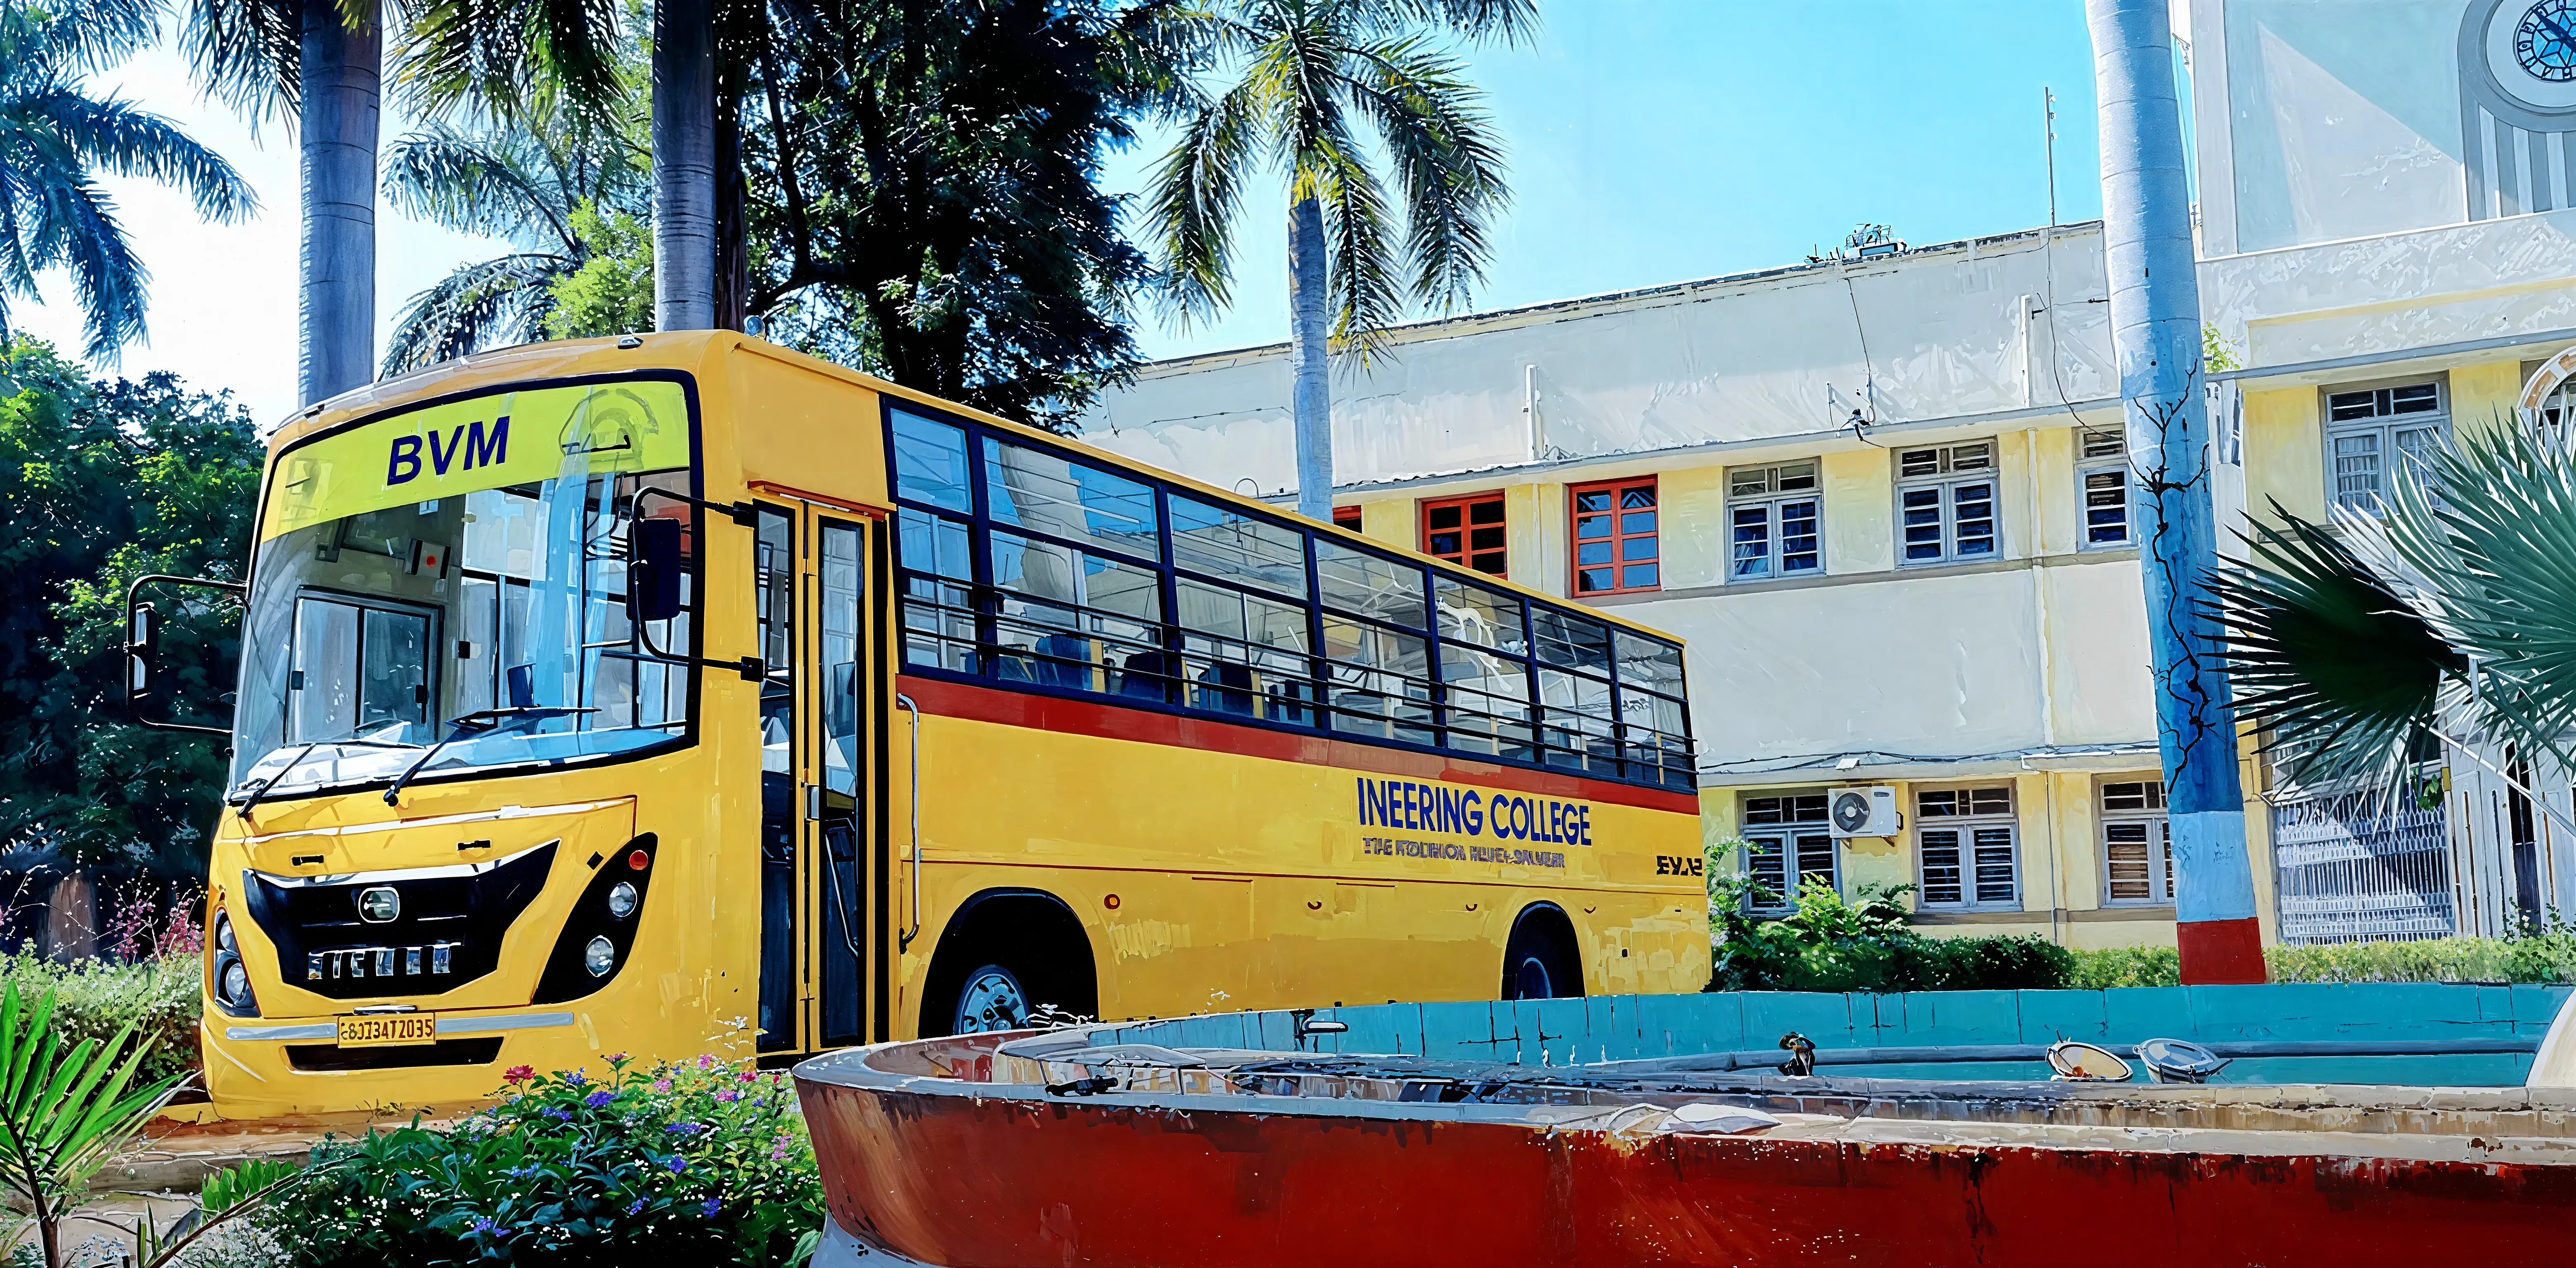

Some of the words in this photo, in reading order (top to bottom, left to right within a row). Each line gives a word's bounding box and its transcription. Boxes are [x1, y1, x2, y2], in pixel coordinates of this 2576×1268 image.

[387, 415, 510, 486] BVM
[1357, 777, 1483, 836] INEERING
[1490, 793, 1592, 846] COLLEGE
